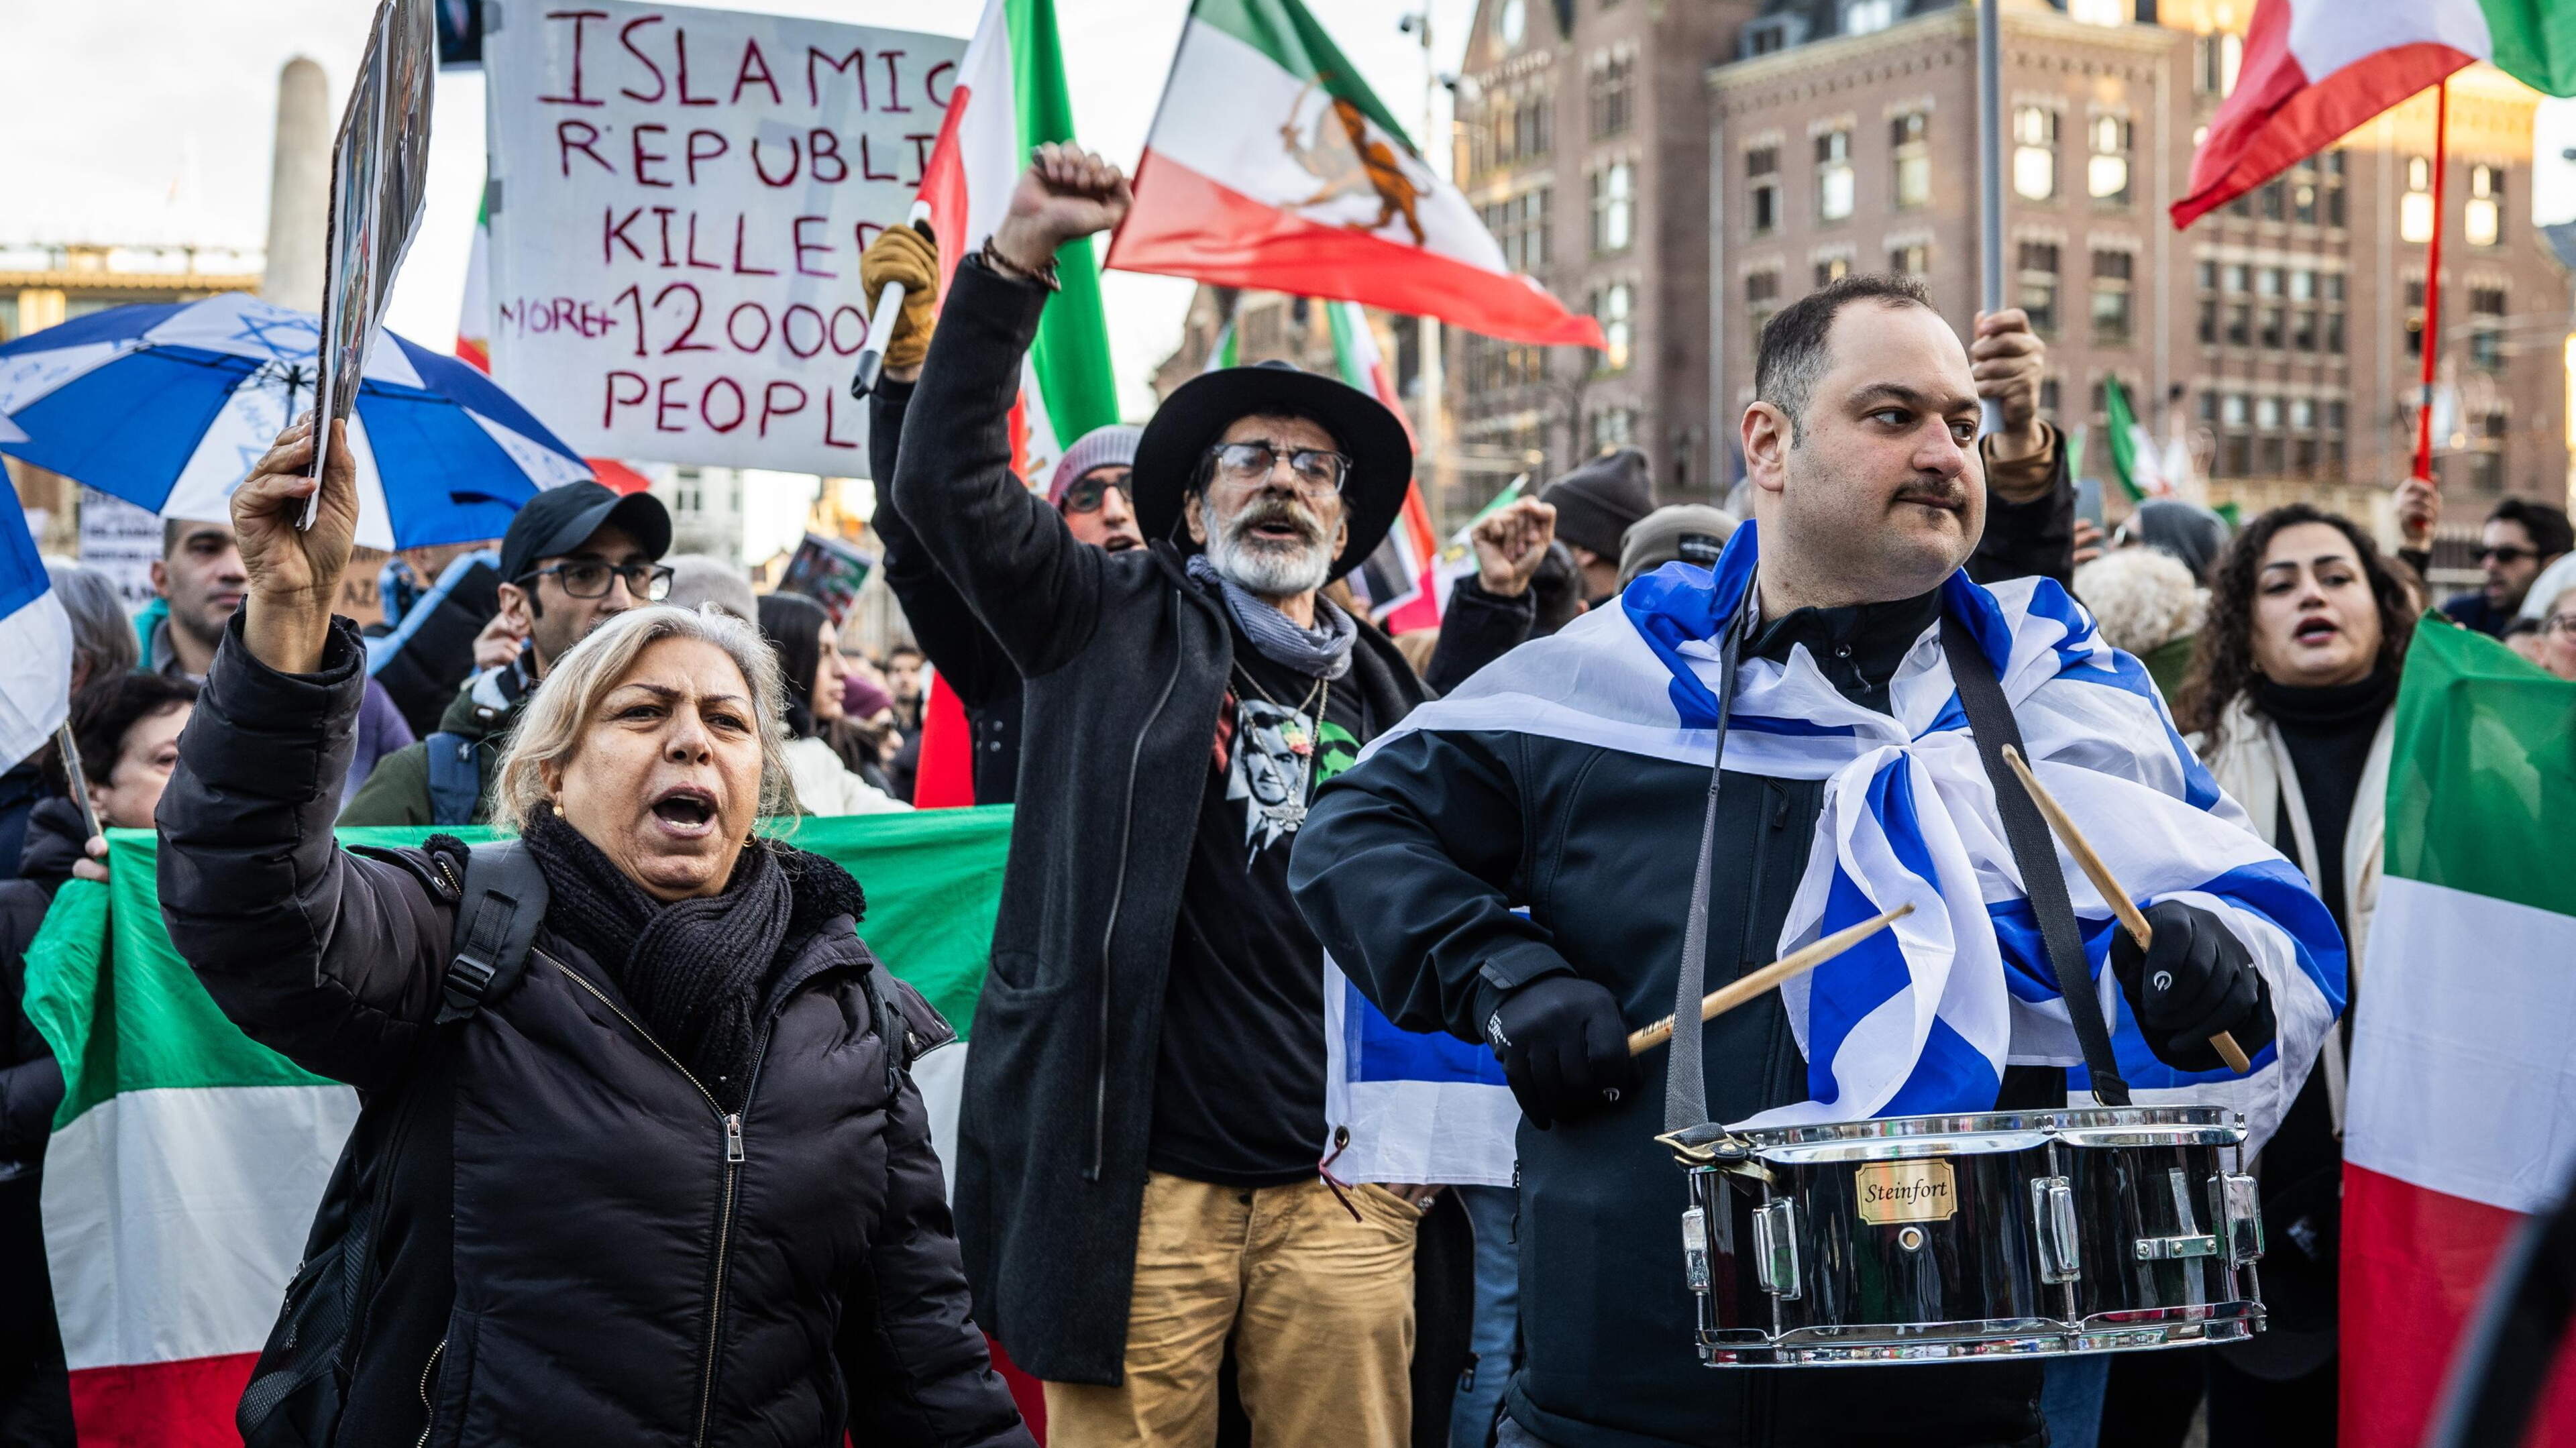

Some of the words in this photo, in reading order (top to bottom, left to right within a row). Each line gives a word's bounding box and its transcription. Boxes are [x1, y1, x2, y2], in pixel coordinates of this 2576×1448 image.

[537, 9, 955, 113] ISLAMIC
[556, 119, 936, 188] REPUBLI
[602, 370, 859, 450] PEOPL
[1865, 1178, 1948, 1205] Steinfort
